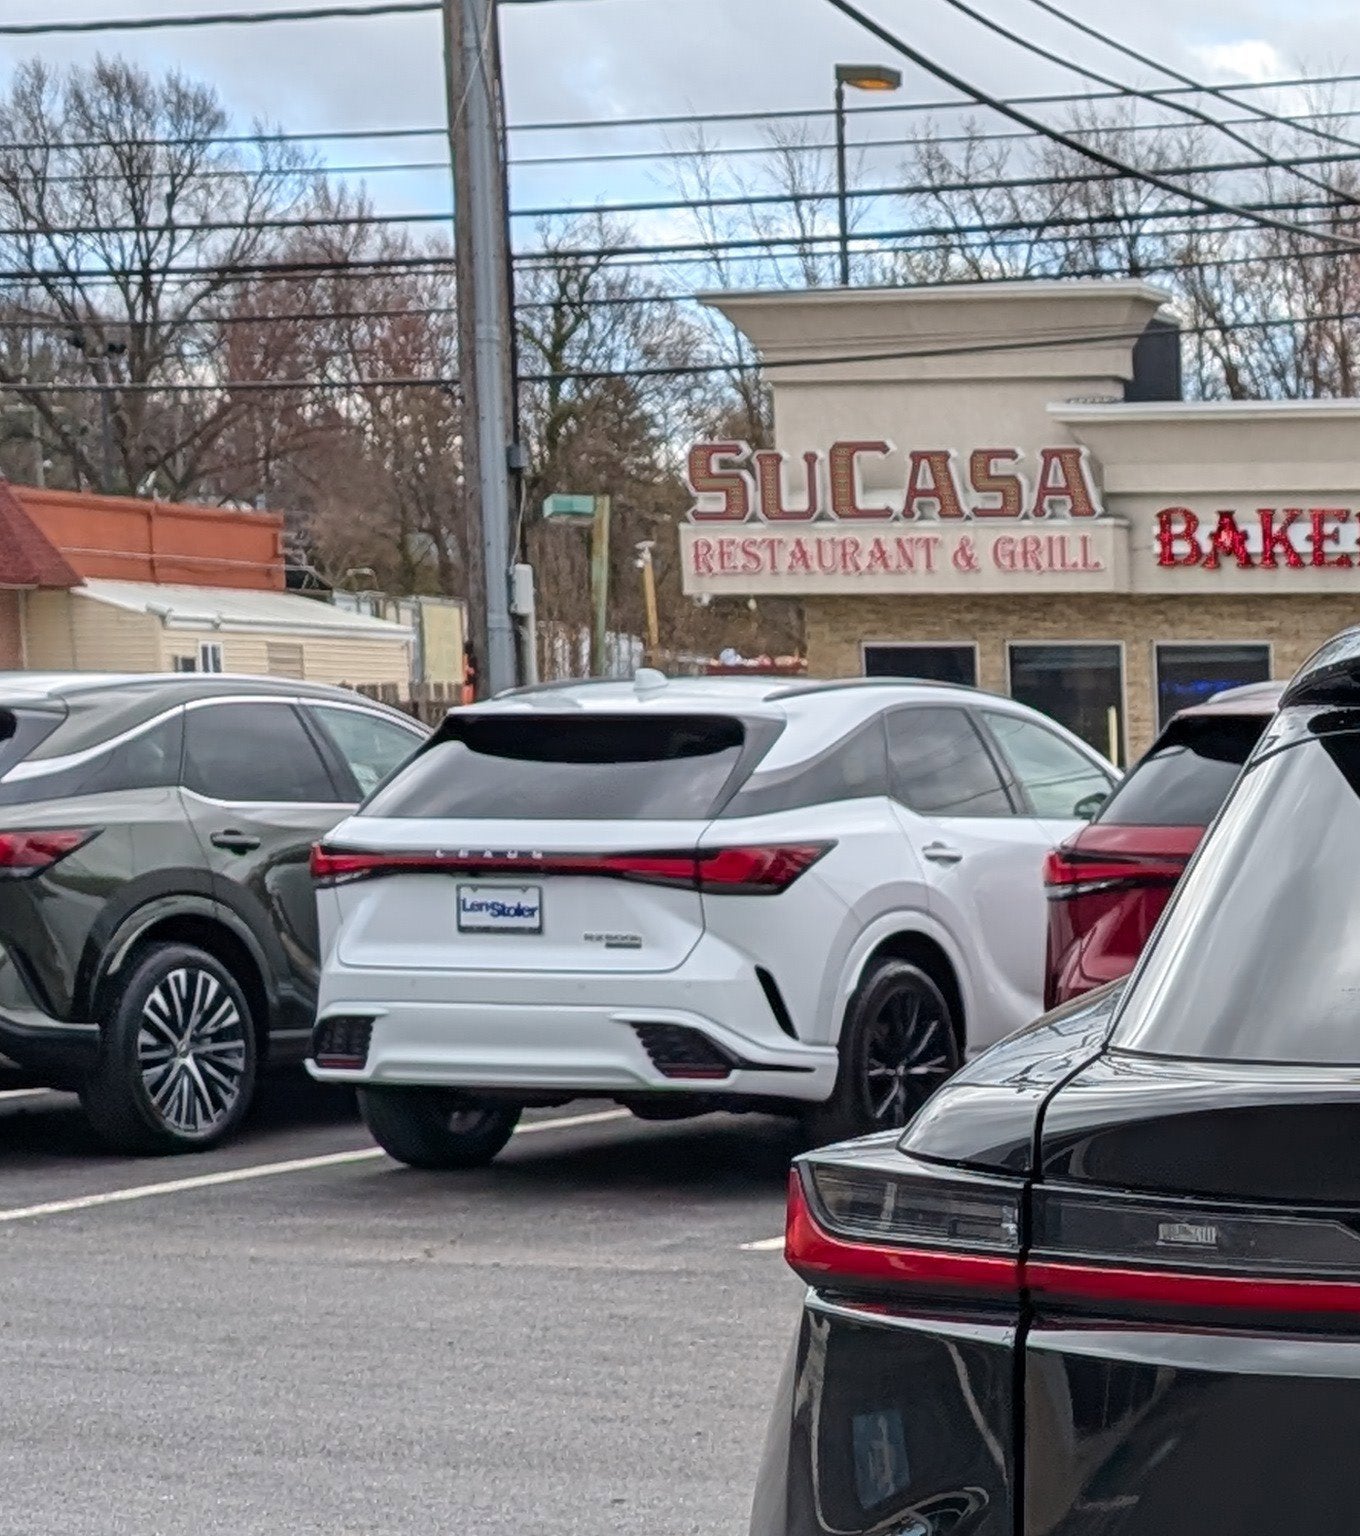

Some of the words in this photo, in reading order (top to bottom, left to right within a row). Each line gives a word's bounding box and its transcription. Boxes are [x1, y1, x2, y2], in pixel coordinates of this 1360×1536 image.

[691, 537, 940, 577] RESTAURANT
[951, 535, 980, 573] &
[992, 534, 1104, 573] GRILL
